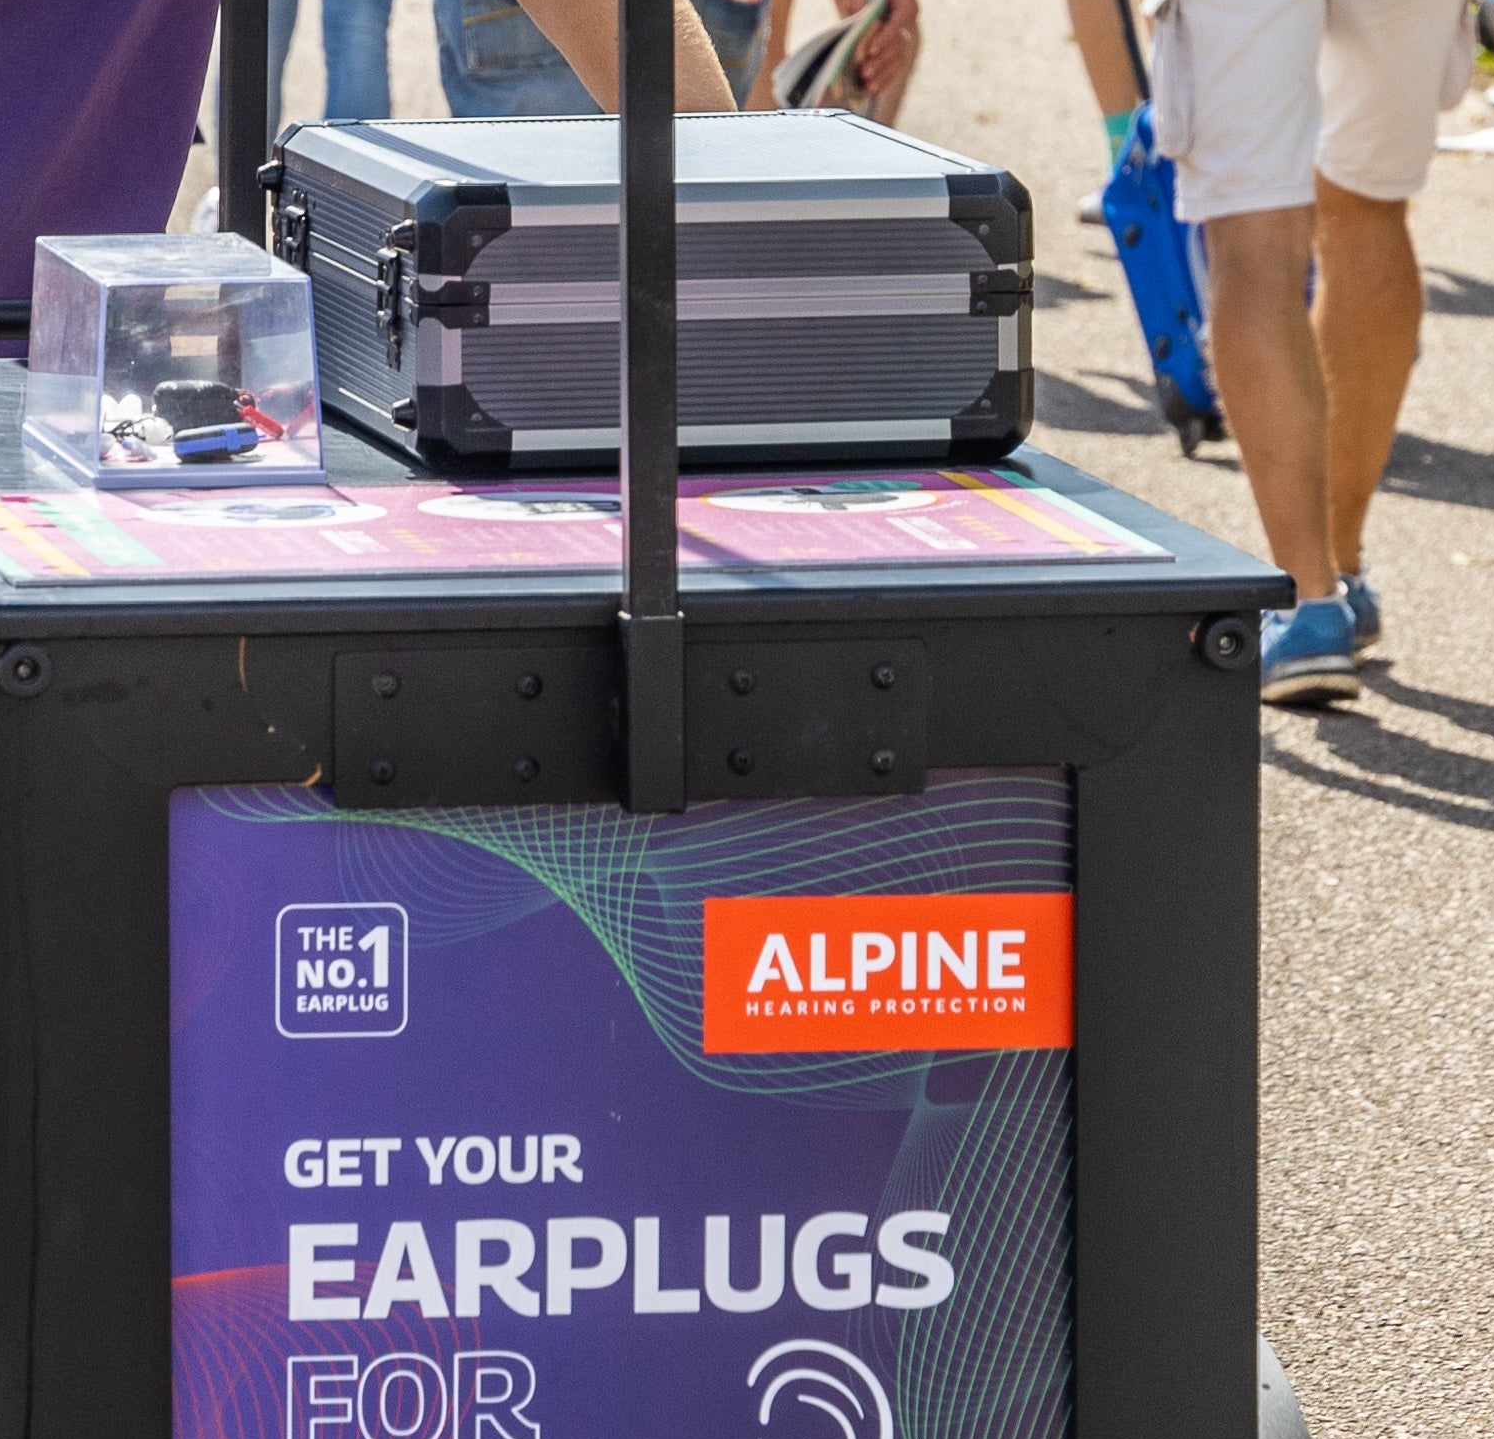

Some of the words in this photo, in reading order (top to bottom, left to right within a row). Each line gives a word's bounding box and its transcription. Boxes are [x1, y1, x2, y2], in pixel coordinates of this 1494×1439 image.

[297, 926, 354, 952] THE
[747, 929, 1026, 993] ALPINE
[296, 993, 389, 1013] EARPLUG
[746, 999, 855, 1016] HEARING
[870, 997, 1026, 1015] PROTECTION
[284, 1137, 401, 1189] GET
[416, 1134, 584, 1186] YOUR
[287, 1209, 956, 1322] EARPLUGS
